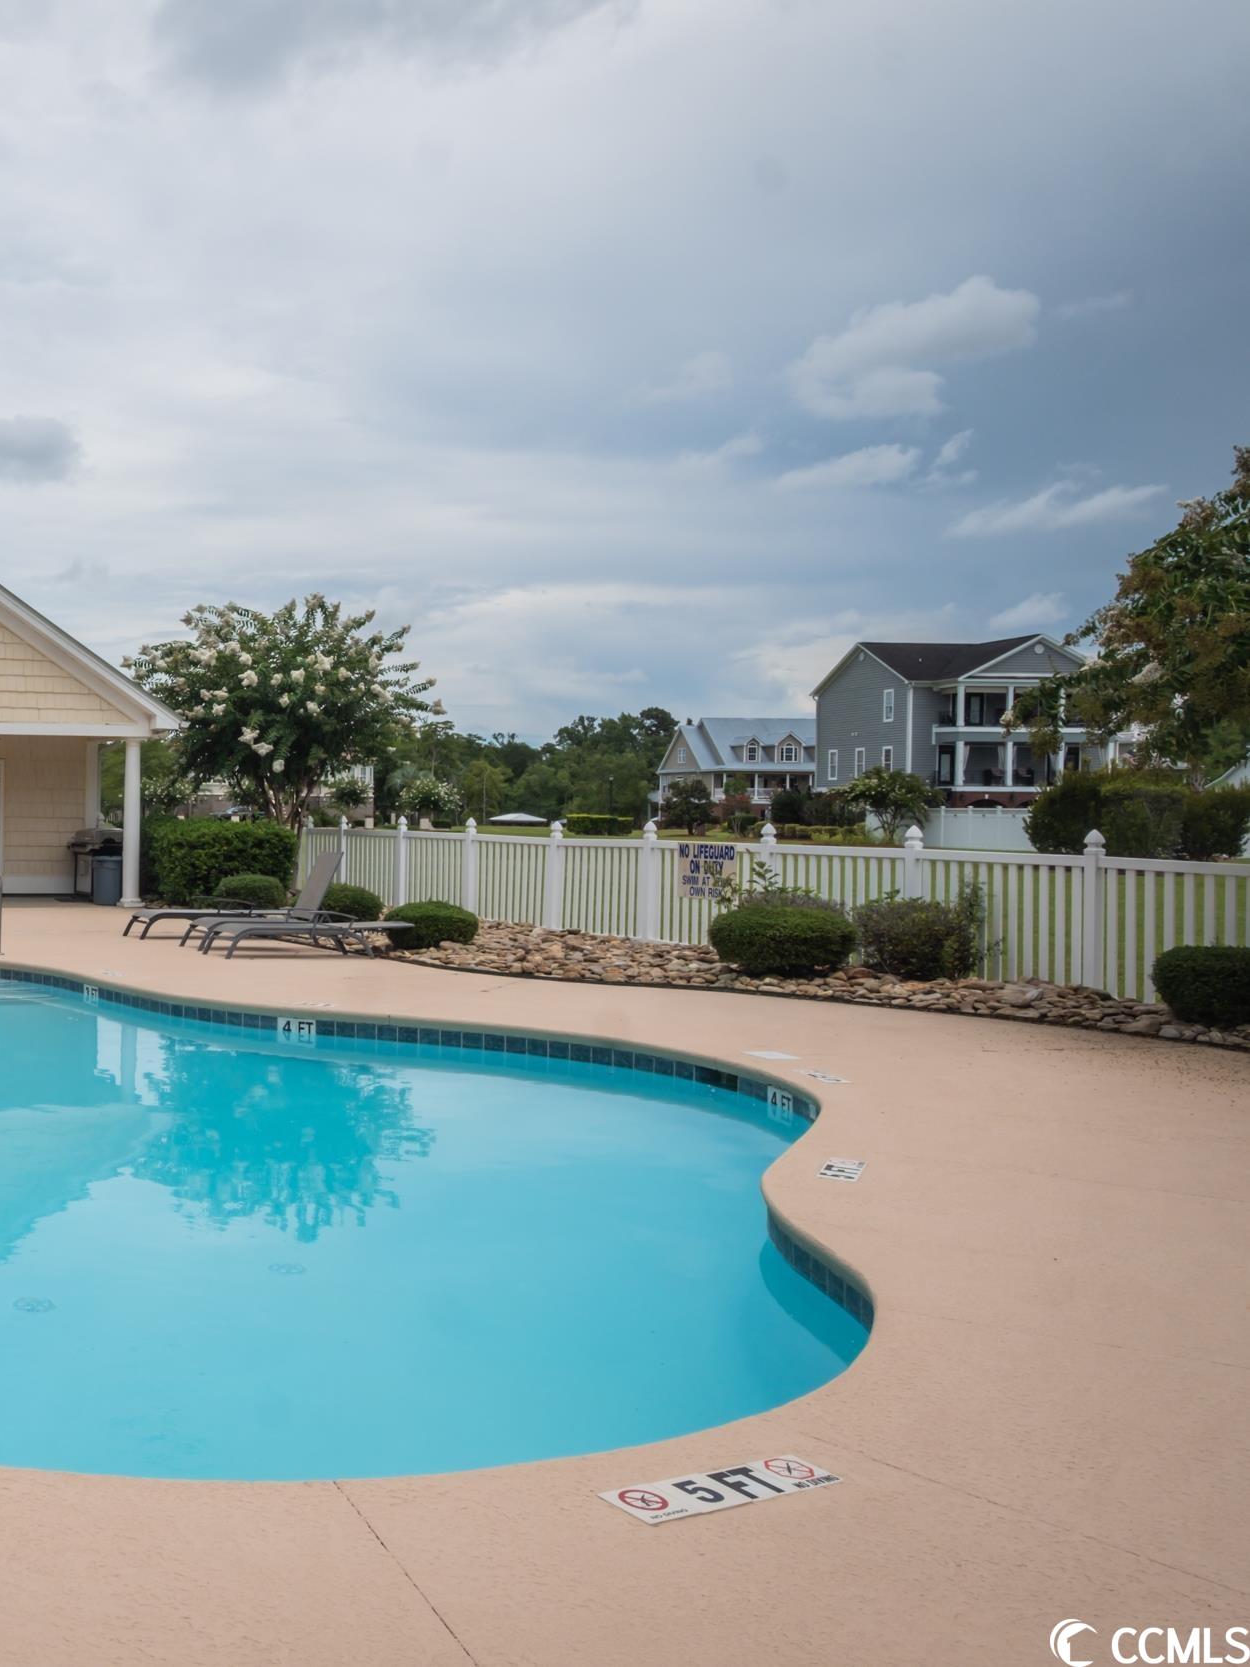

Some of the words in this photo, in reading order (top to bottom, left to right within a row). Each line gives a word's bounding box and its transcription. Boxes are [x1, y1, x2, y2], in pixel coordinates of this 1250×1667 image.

[679, 843, 690, 858] NO
[693, 844, 735, 860] LIFEGUARD
[690, 860, 700, 874] ON
[682, 875, 699, 886] SWIM
[702, 876, 710, 886] AT
[690, 886, 706, 897] OWN
[708, 887, 723, 898] RISK
[282, 1020, 292, 1032] 4
[298, 1021, 314, 1034] FT
[771, 1091, 777, 1106] 4
[781, 1094, 791, 1111] FT
[672, 1479, 725, 1503] 5
[706, 1466, 785, 1499] FT
[792, 1481, 810, 1489] NO
[806, 1474, 840, 1486] DIVING
